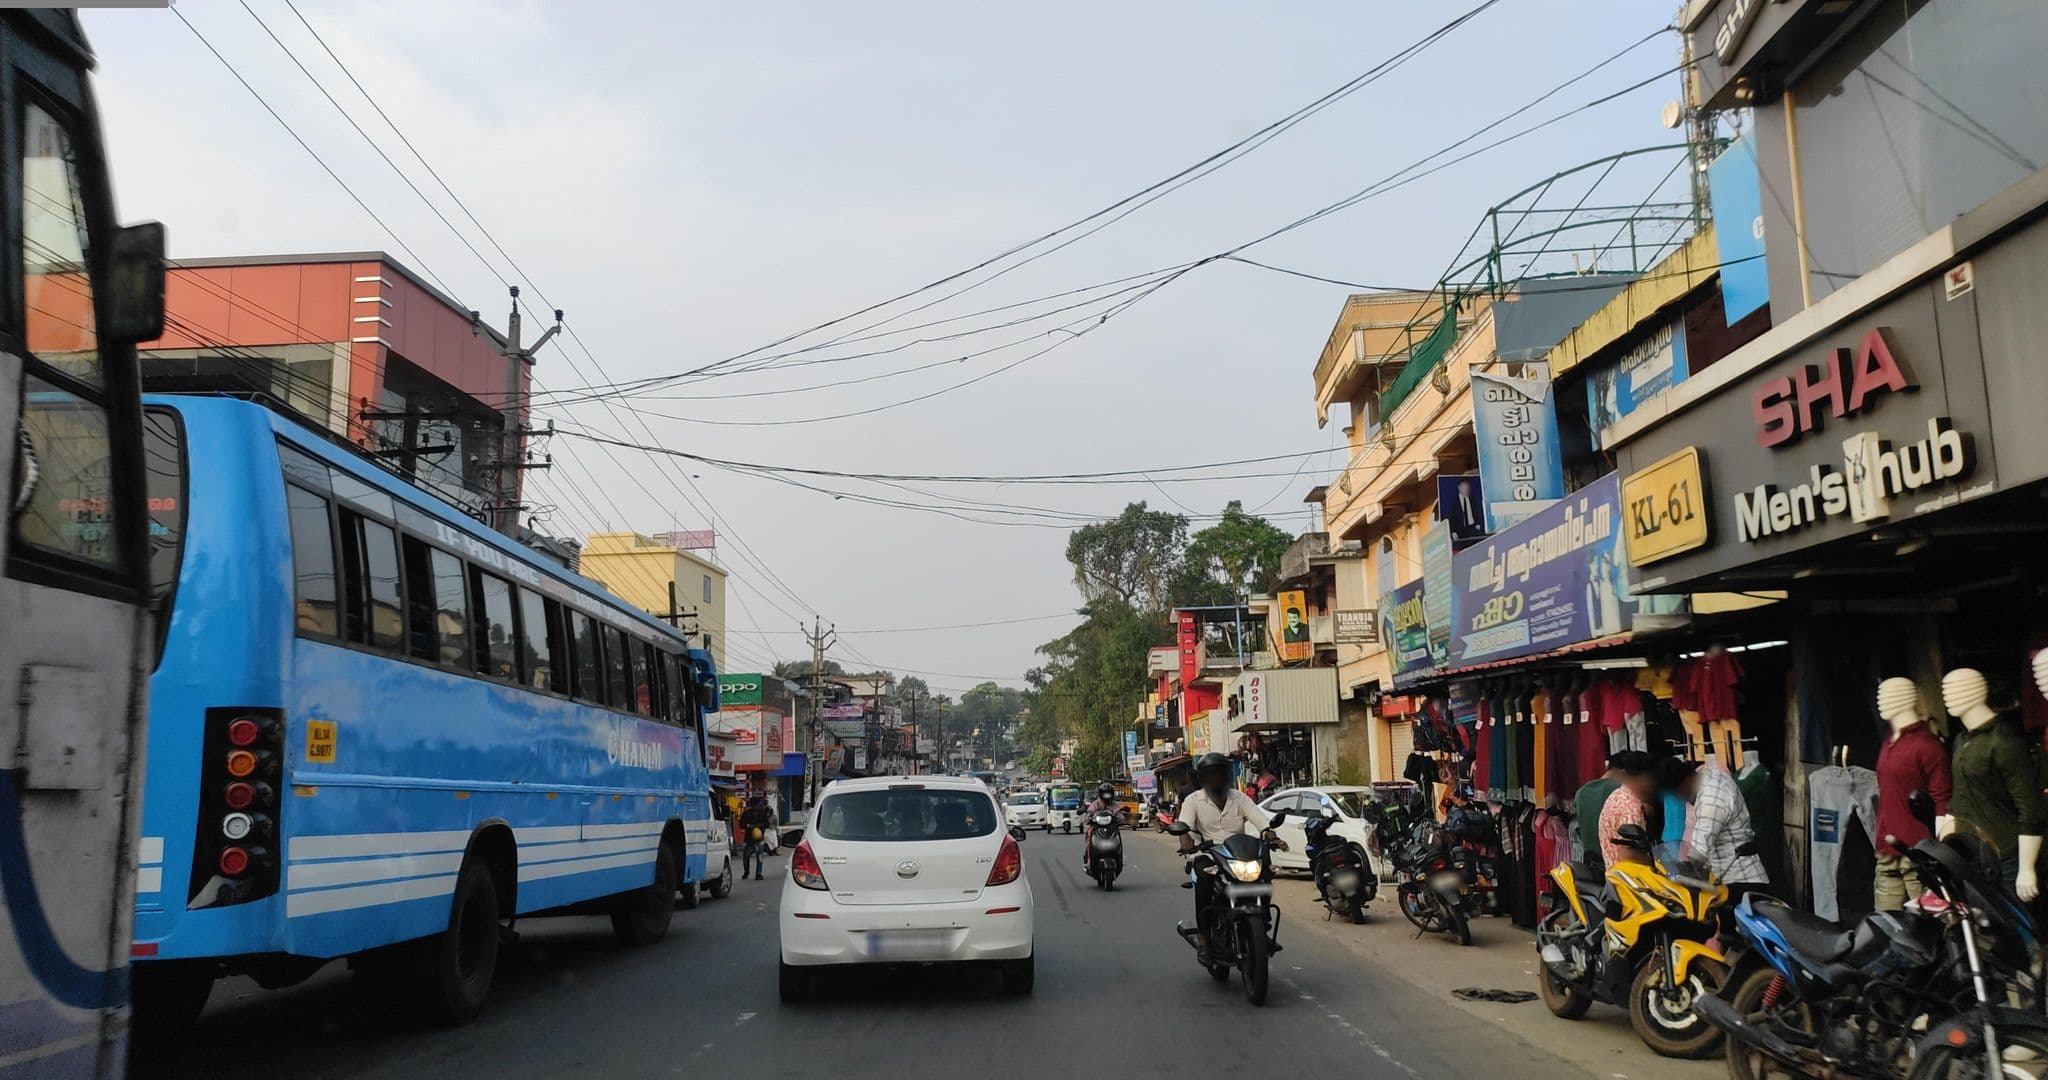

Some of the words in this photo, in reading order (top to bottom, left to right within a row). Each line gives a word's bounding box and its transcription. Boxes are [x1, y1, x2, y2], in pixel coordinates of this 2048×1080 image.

[1752, 327, 1909, 449] SHA
[1631, 480, 1695, 540] KL-61
[1733, 463, 1850, 544] Men's
[1876, 416, 1966, 499] hub
[719, 682, 758, 695] ppo
